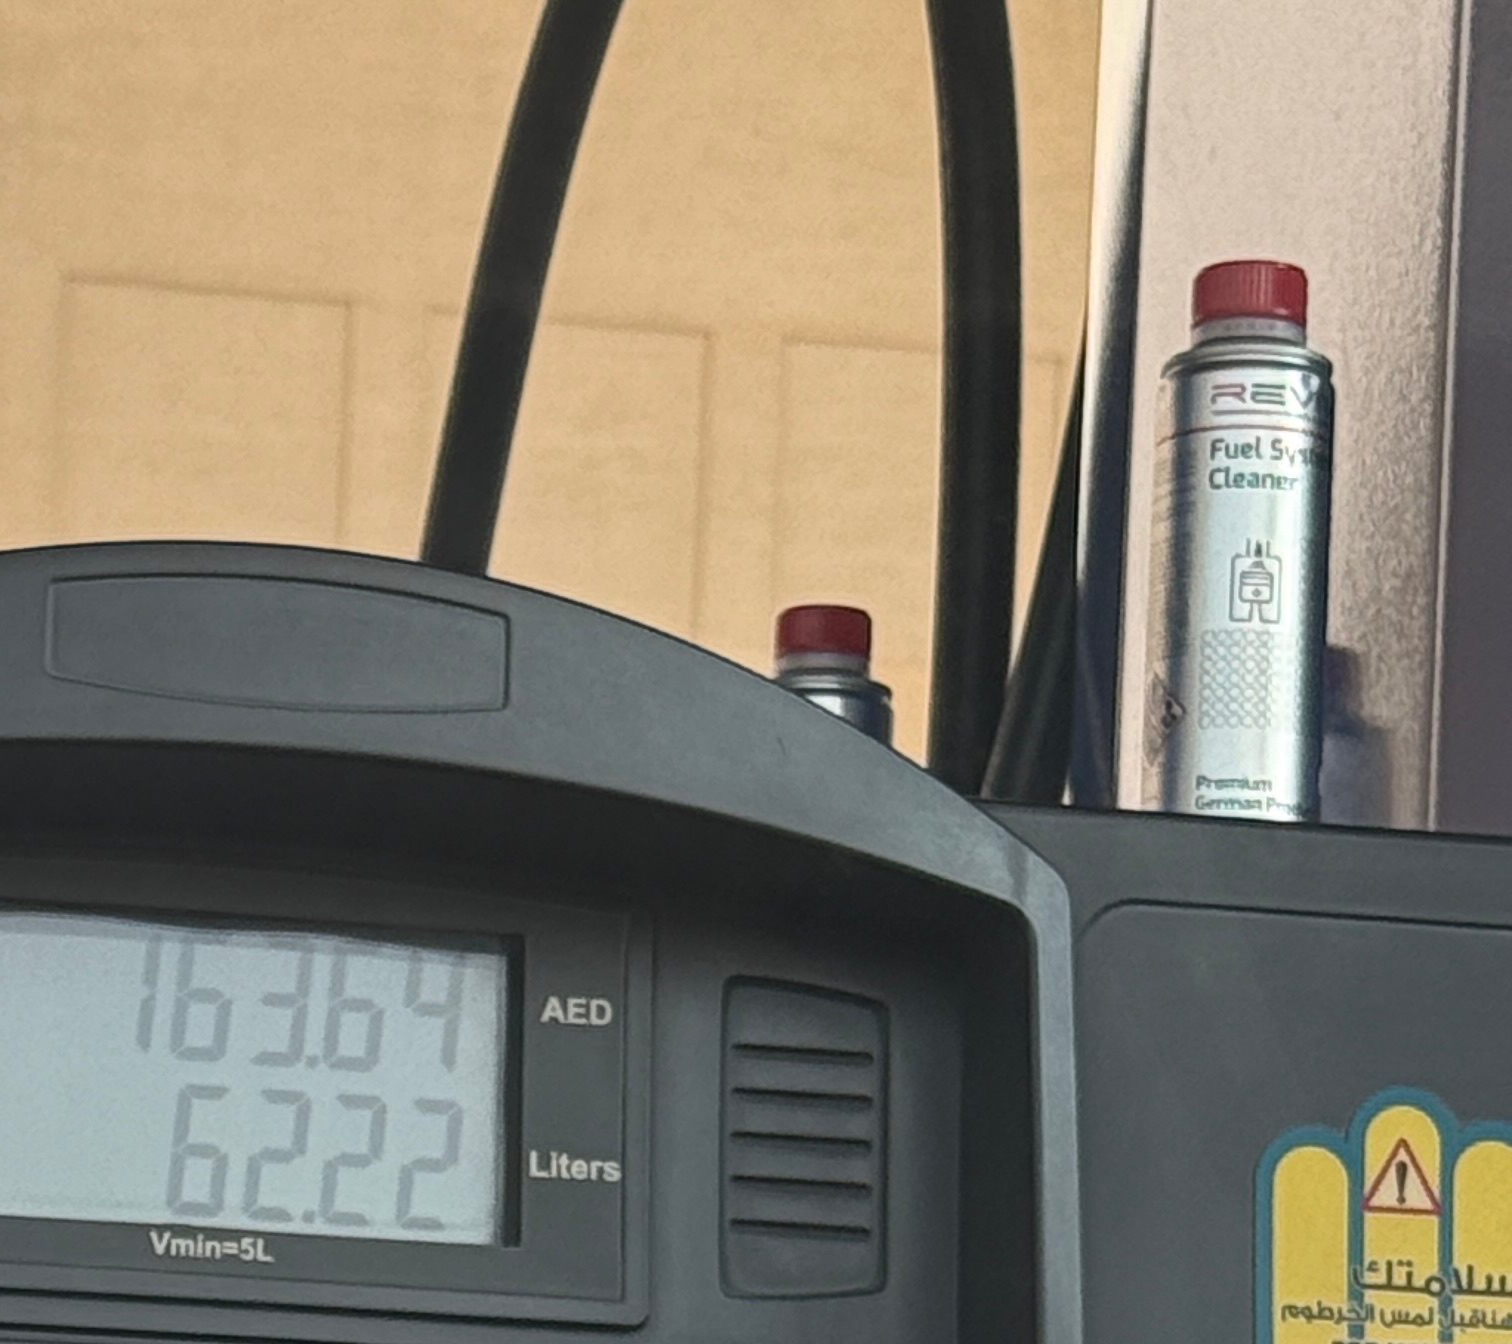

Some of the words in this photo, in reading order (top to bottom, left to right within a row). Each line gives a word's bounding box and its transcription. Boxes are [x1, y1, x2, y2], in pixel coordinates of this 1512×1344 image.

[1209, 435, 1263, 461] Fuel
[1207, 466, 1299, 491] Cleaner
[1195, 774, 1273, 793] Premium
[138, 937, 464, 1072] 163.64
[540, 996, 613, 1027] AED
[167, 1083, 464, 1231] 62.22
[529, 1151, 621, 1183] Liters
[149, 1231, 275, 1265] Vmin=5L
